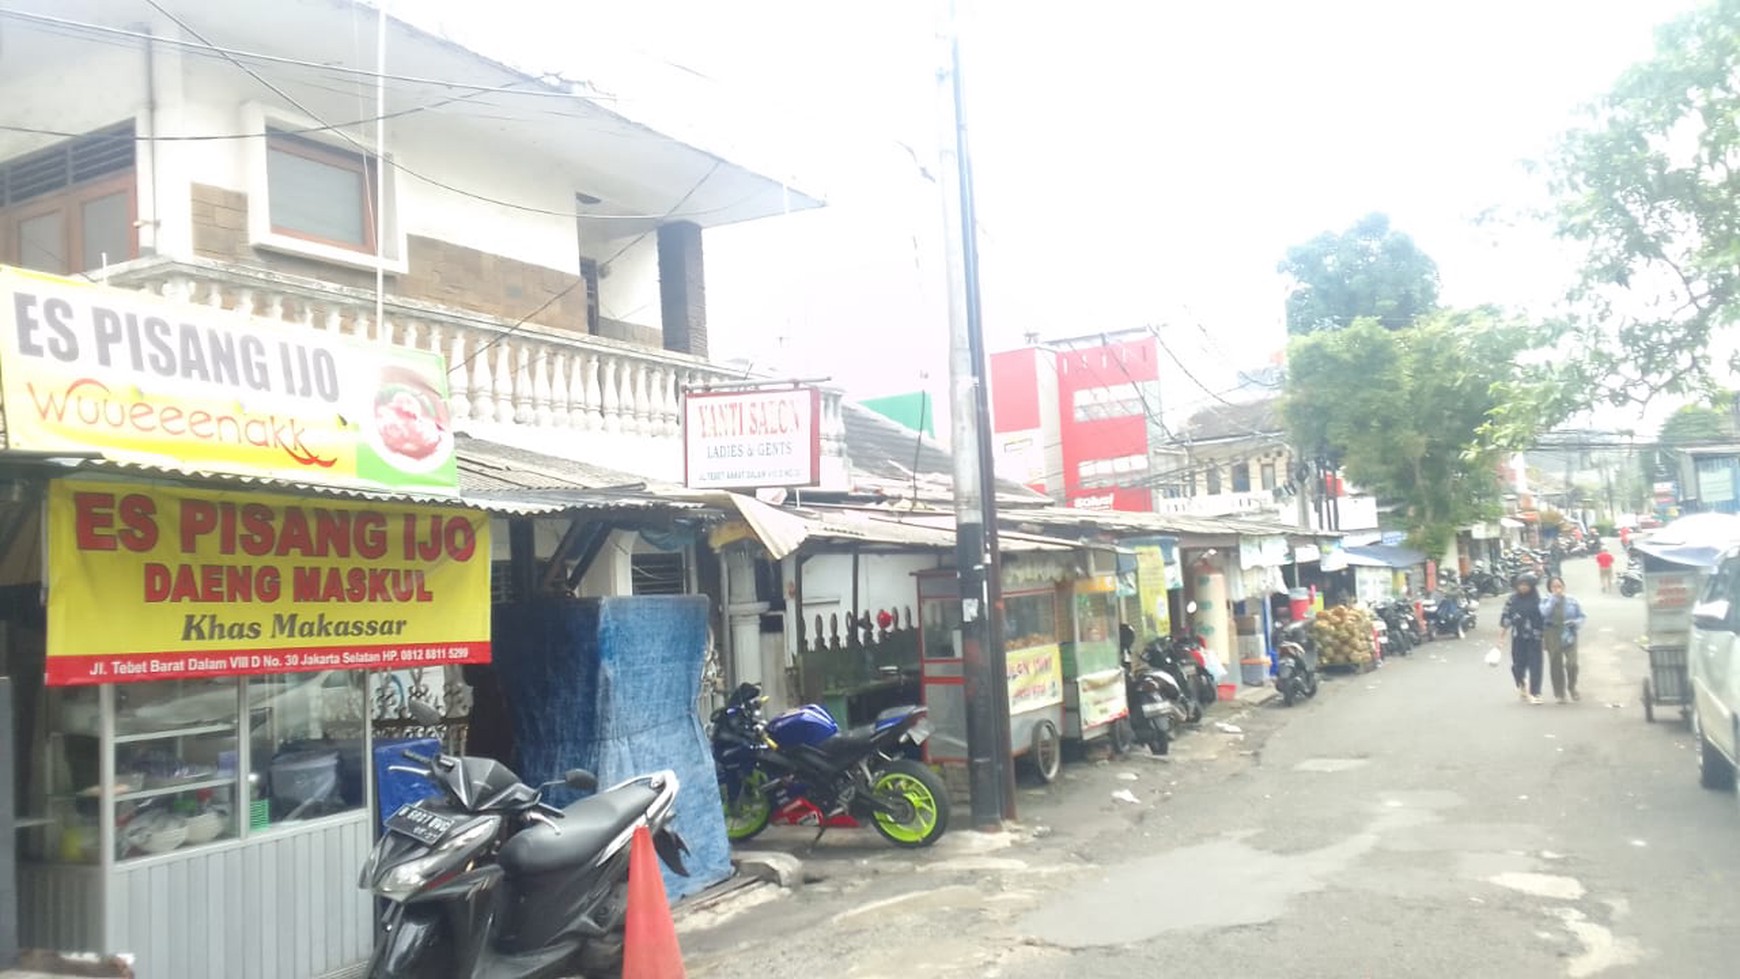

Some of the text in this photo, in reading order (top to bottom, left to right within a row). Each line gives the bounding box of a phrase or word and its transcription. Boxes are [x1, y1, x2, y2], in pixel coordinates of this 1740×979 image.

[14, 292, 339, 403] ES PISANG IJO
[698, 398, 801, 438] YANTI SALON
[707, 443, 744, 459] LADIES
[758, 441, 793, 457] GENTS
[74, 493, 478, 563] ES PISANG IJO
[144, 563, 433, 603] DAENG MASKUL
[181, 613, 407, 641] Khas Makassar
[111, 661, 147, 674] Tebet
[150, 659, 184, 673] Barat
[188, 658, 226, 671] Dalam
[230, 656, 248, 668] VIII
[251, 656, 260, 668] D
[263, 655, 282, 667] No.
[284, 654, 298, 666] 30
[300, 653, 340, 666] Jakarta
[342, 651, 381, 664] Selatan
[383, 650, 399, 662] HP.
[401, 649, 423, 661] 0812
